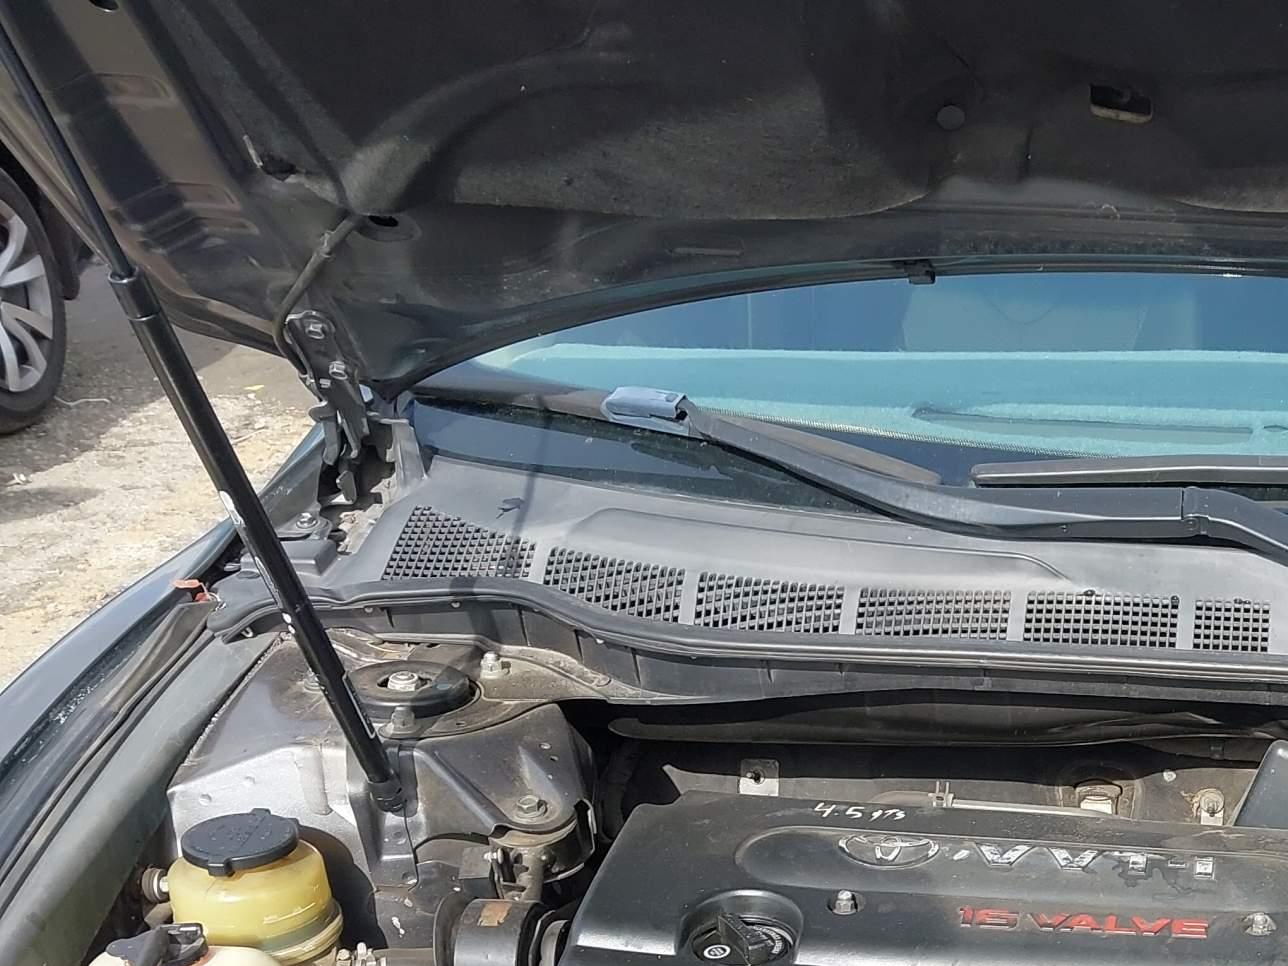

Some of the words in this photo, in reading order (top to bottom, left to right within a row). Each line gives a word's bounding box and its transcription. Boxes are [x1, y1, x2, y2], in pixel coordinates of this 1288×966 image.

[814, 802, 865, 819] 4.5
[959, 906, 1019, 930] 16
[1027, 912, 1209, 938] VALVE
